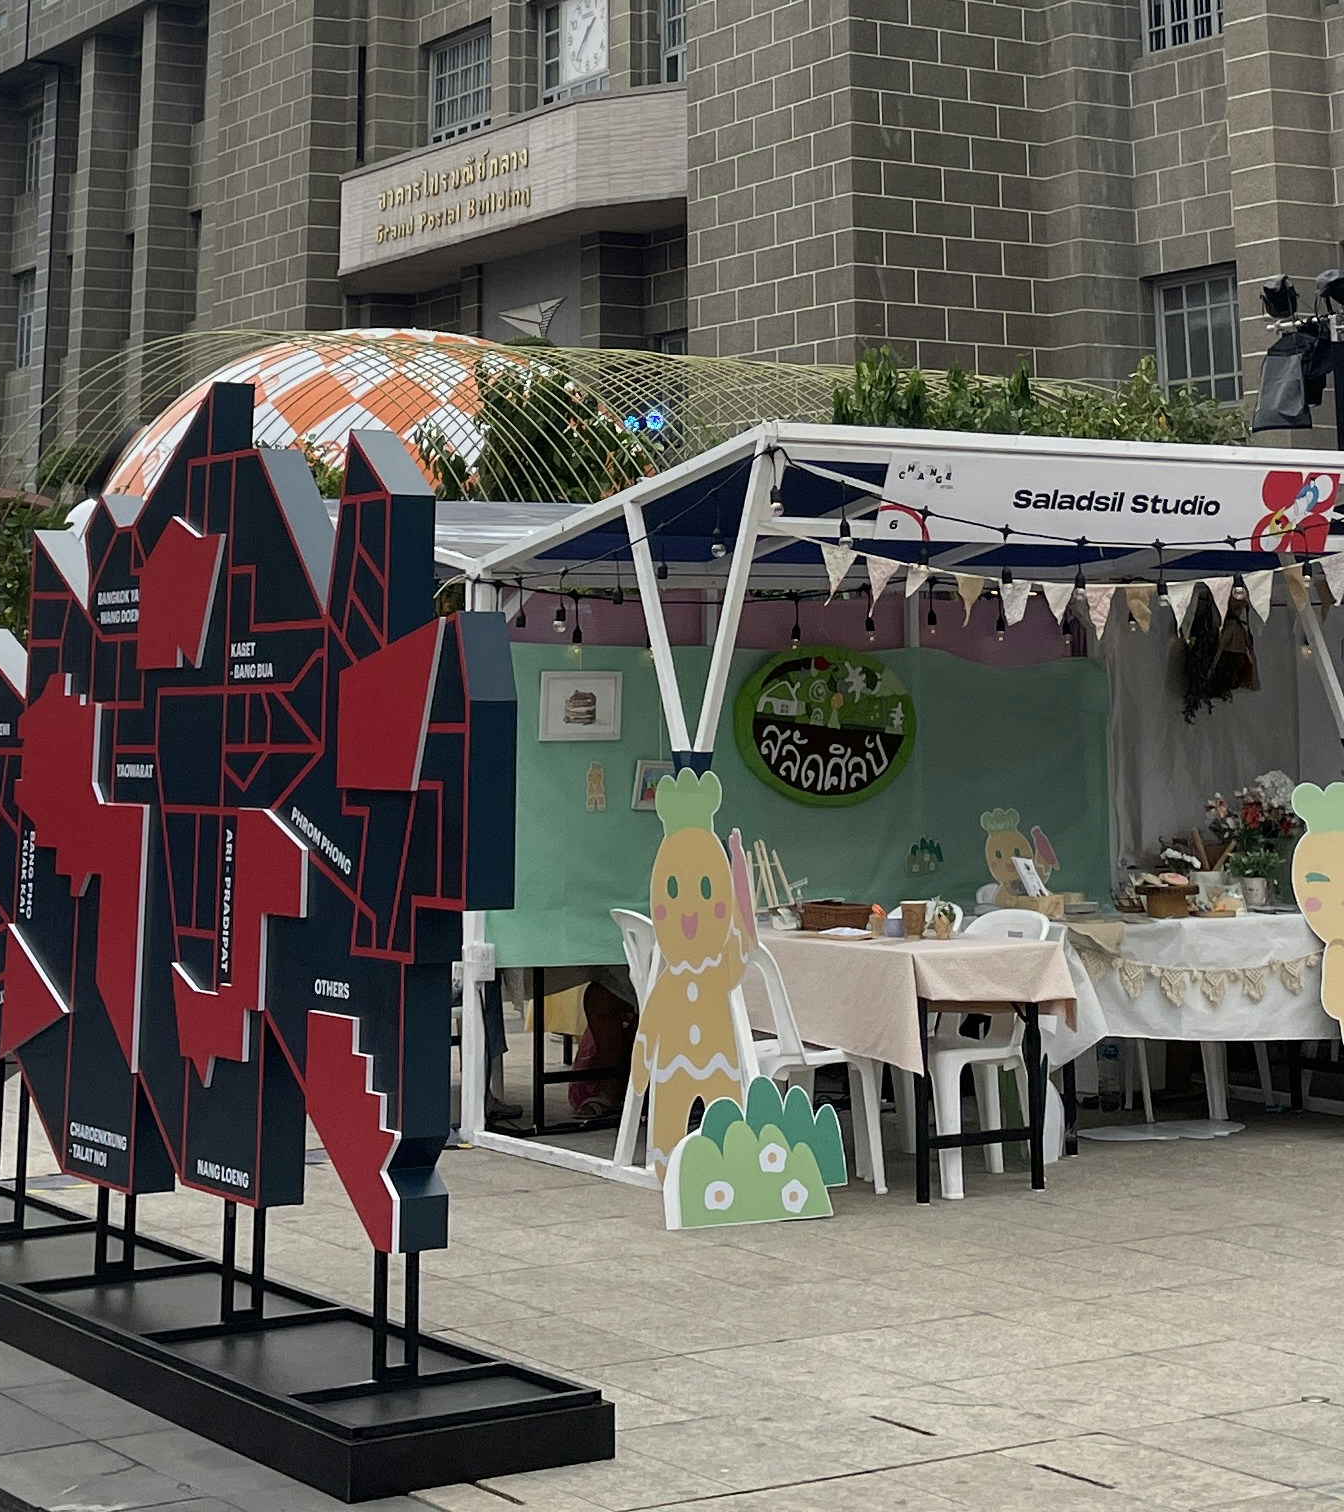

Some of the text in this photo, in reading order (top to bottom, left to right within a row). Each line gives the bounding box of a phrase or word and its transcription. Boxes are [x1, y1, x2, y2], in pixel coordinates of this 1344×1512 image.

[378, 147, 529, 212] อาคารไปรษณีย์กลาง
[376, 185, 531, 245] Grand Postal Building
[1013, 489, 1221, 517] Saladsil Studio
[889, 519, 898, 530] 6
[98, 589, 140, 606] BANGKOK YA
[100, 610, 121, 624] WANG
[230, 642, 257, 658] KASET
[233, 663, 257, 680] BANG
[257, 662, 274, 678] BUA
[116, 764, 154, 779] YAOWARAT
[27, 830, 36, 880] BANG
[225, 828, 234, 862] ARI
[291, 806, 352, 876] PHROM PHONG
[19, 884, 27, 914] KAI
[220, 876, 233, 974] PRADIPAT
[314, 978, 351, 1000] OTHERS
[72, 1143, 94, 1163] TALAT
[93, 1150, 108, 1168] NOI
[196, 1158, 250, 1189] NANG LOENG
